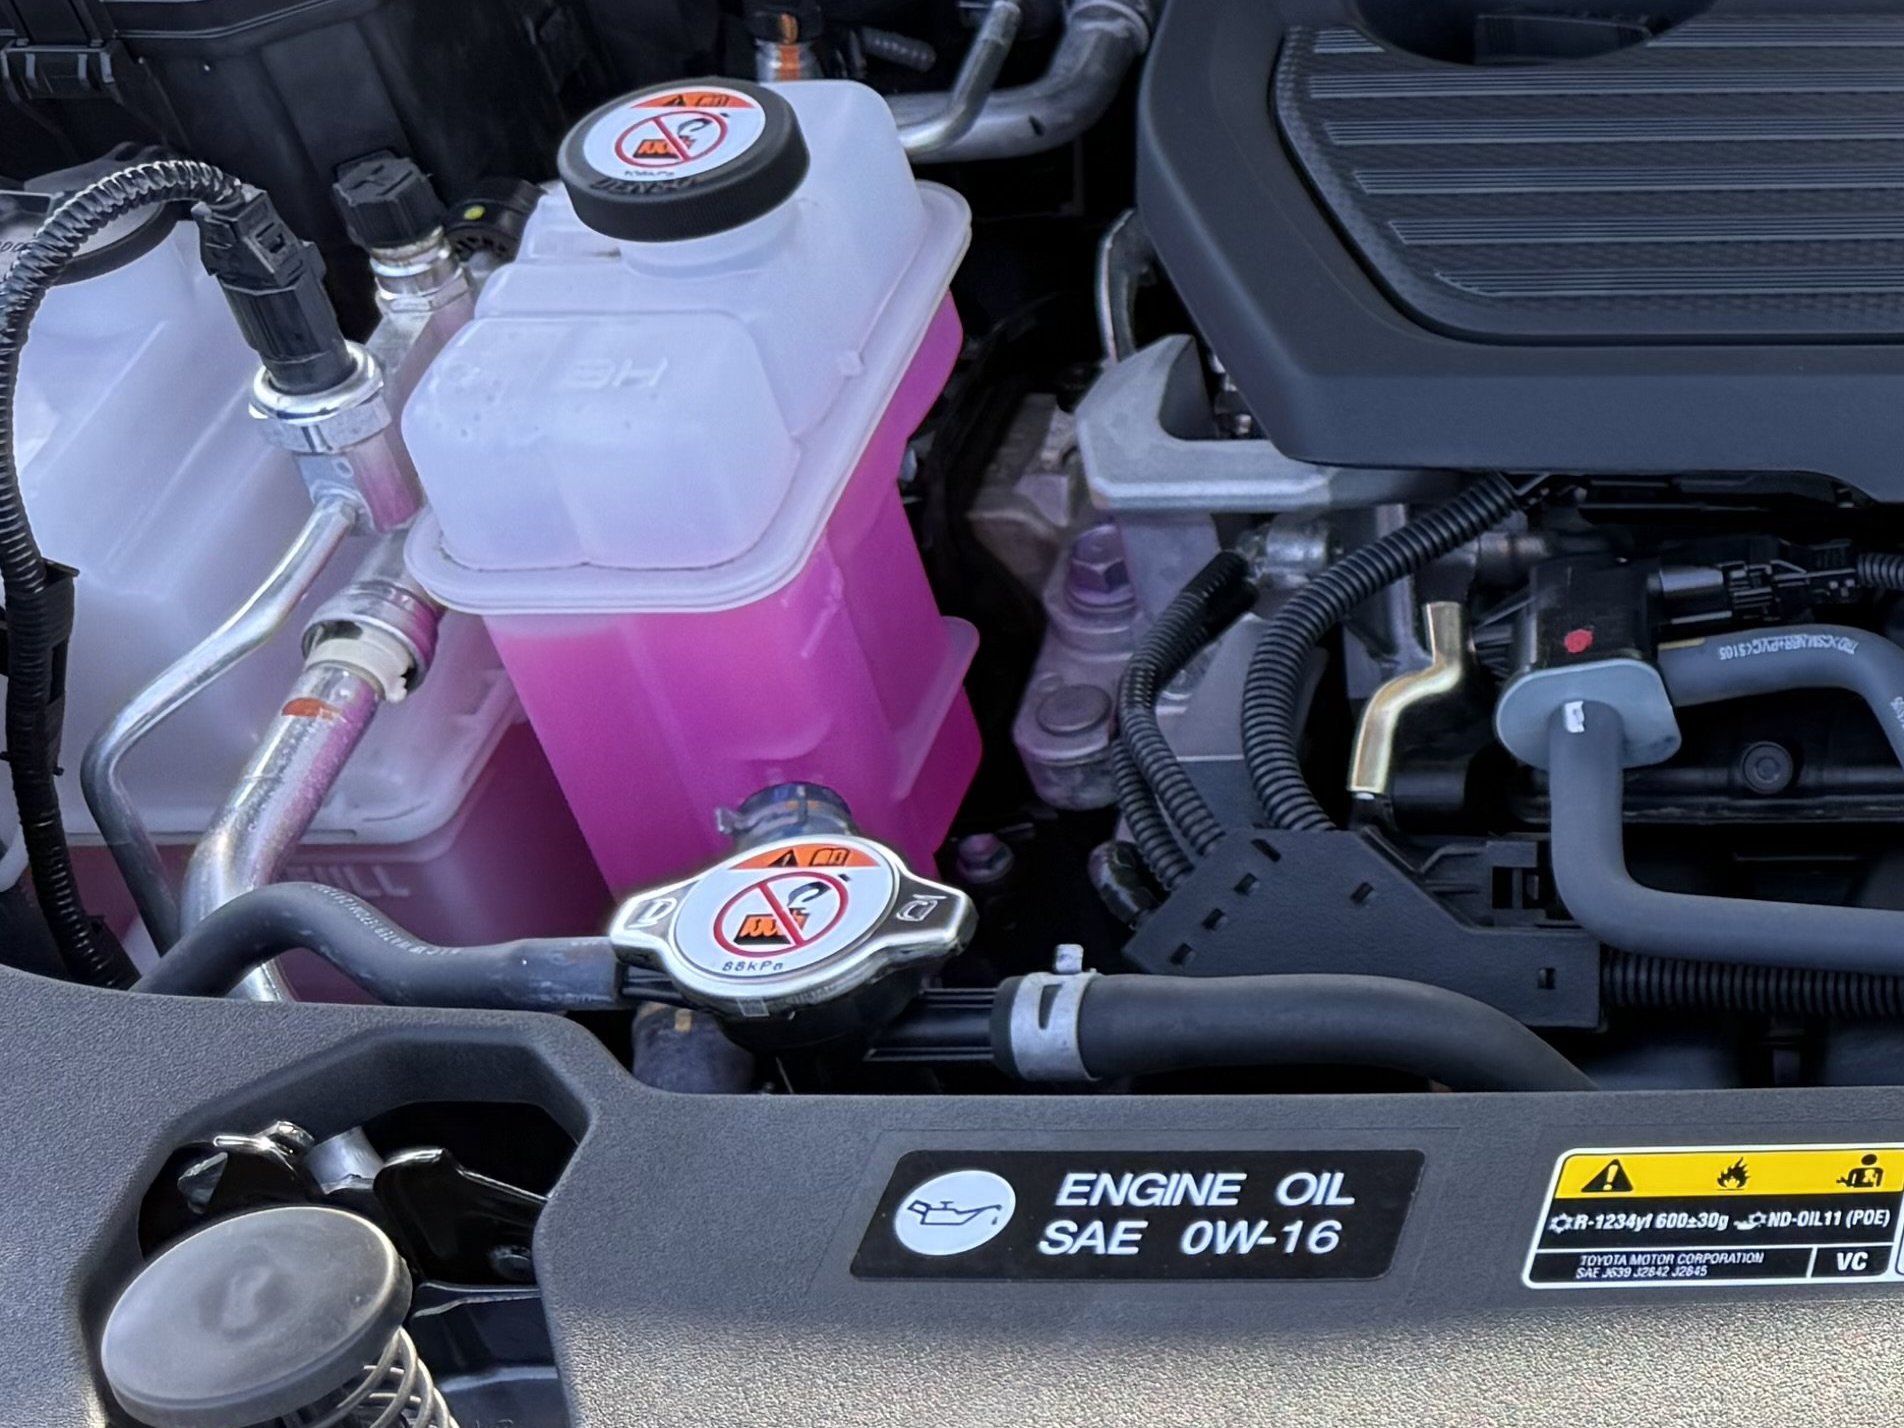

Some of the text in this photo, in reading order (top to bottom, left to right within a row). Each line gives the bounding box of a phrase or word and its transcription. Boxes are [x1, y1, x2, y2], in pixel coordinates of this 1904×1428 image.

[721, 961, 784, 972] 88kPa
[1055, 1172, 1356, 1207] ENGINE OIL
[1573, 1209, 1891, 1233] R-1234yf 600±30g ND-OIL11 (POE)
[1038, 1220, 1343, 1255] SAE 0W-16
[1580, 1252, 1765, 1266] TOYOTA MOTOR CORPORATION
[1836, 1252, 1869, 1271] VC
[1576, 1267, 1600, 1279] SAE
